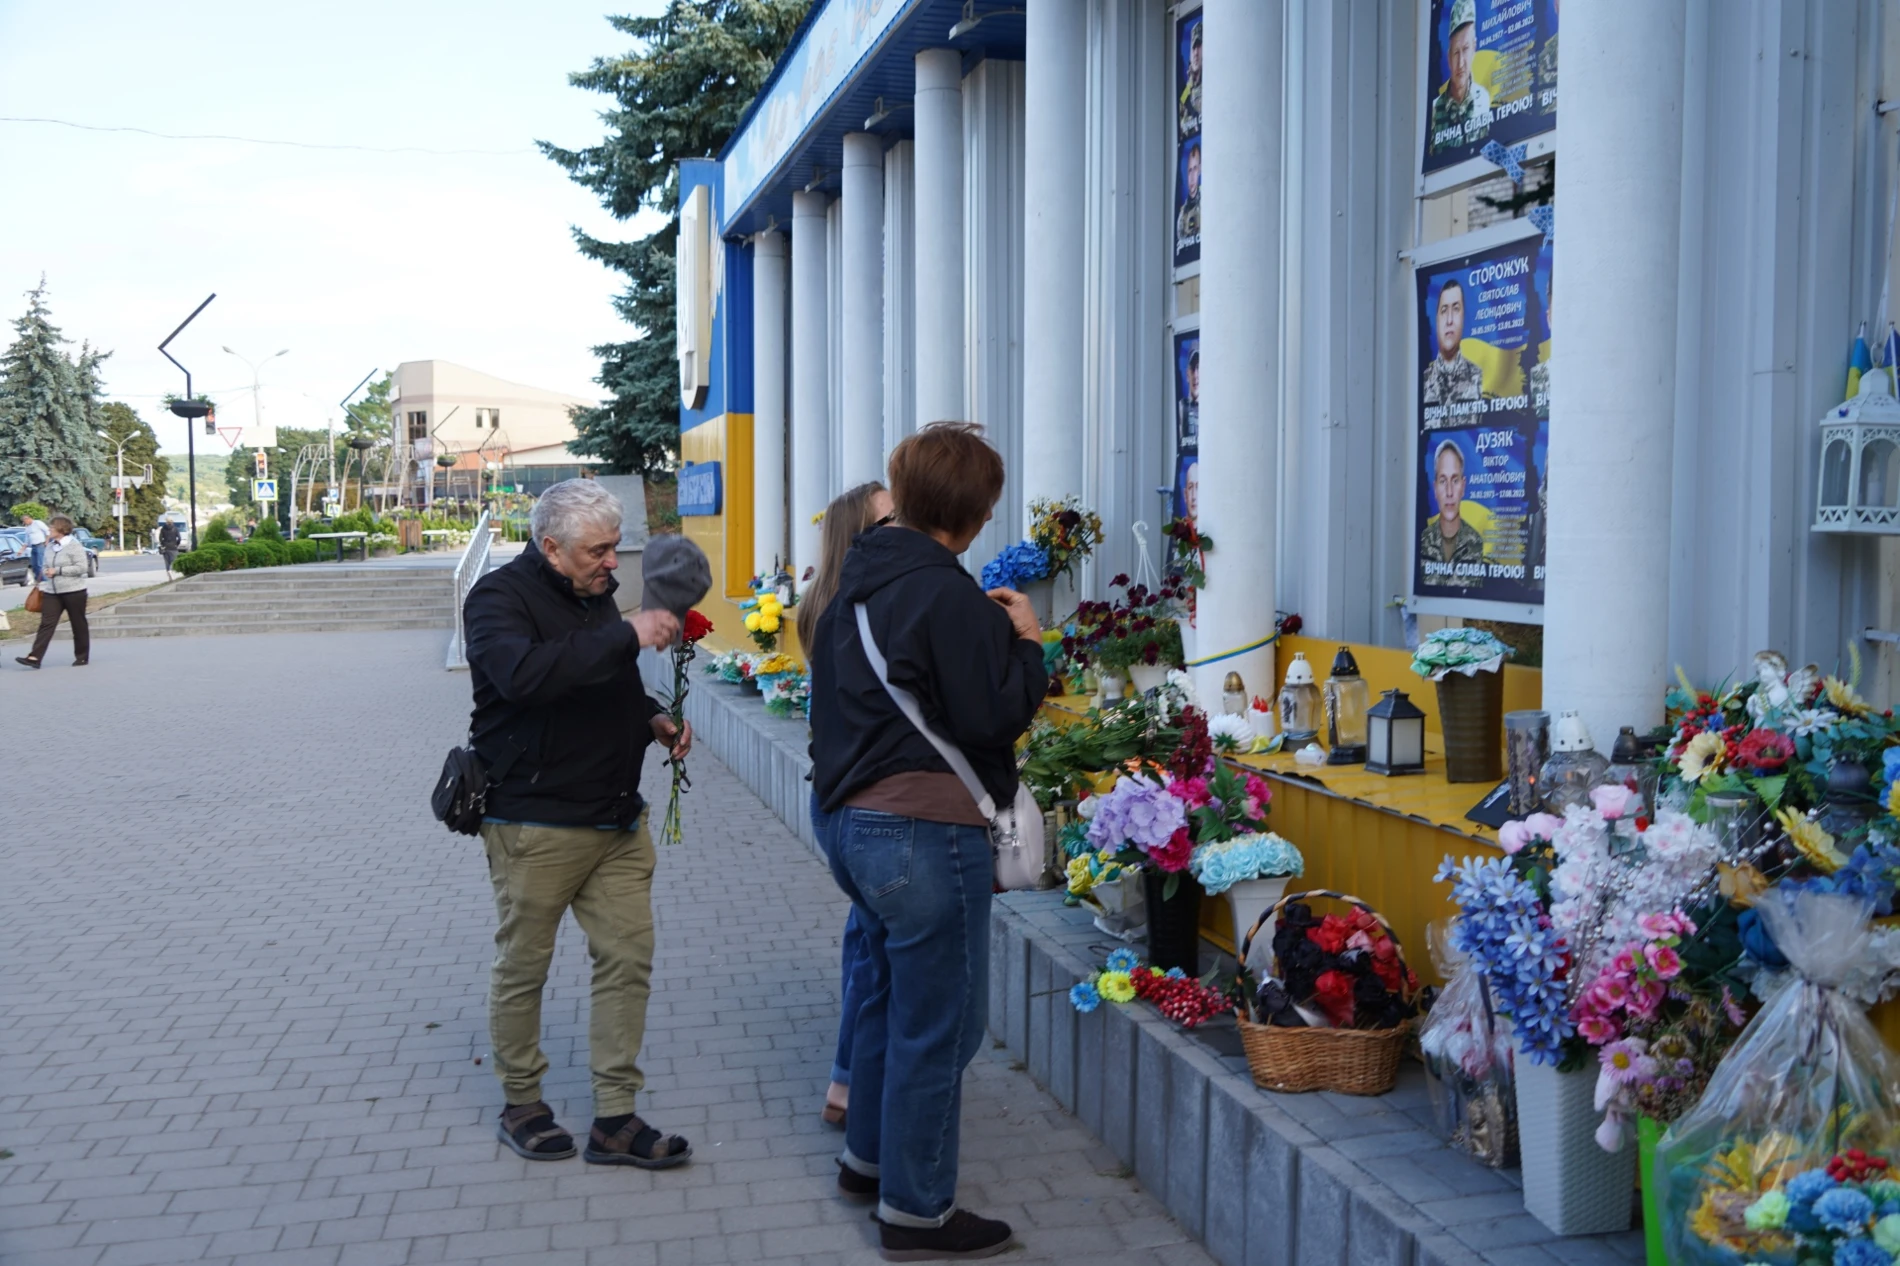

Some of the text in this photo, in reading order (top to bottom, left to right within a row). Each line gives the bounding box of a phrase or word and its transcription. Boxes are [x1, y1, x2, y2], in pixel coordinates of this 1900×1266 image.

[1434, 93, 1533, 146] ВІЧНА СЛАВА ГЕРОЮ!
[1468, 256, 1530, 287] СТОРОЖУК
[1478, 283, 1520, 303] СВЯТОСЛАВ
[1474, 301, 1522, 320] ЛЕОНІДОВИЧ
[1424, 394, 1528, 420] ВІЧНА ПАМ'ЯТЬ ГЕРОЮ!
[1475, 430, 1514, 454] ДУЗЯК
[1482, 454, 1510, 468] ВІКТОР
[1469, 470, 1526, 484] АНАТОЛІЙОВИЧ
[1425, 562, 1525, 579] ВІЧНА СЛАВА ГЕРОЮ!
